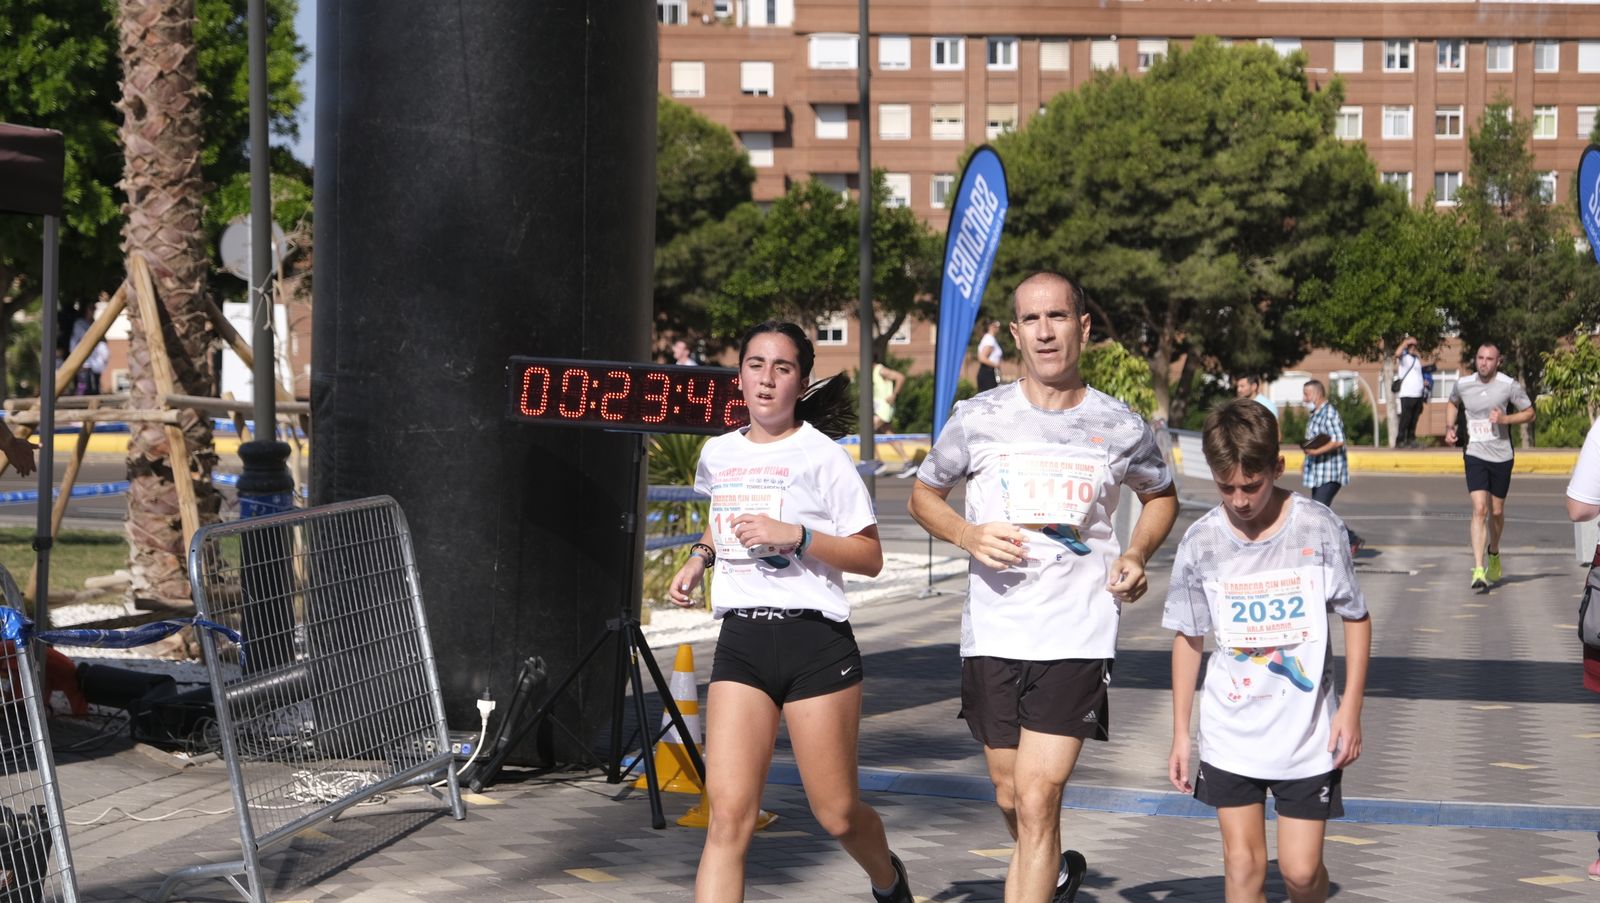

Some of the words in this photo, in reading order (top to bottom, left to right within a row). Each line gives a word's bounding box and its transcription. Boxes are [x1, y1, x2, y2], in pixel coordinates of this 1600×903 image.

[1023, 478, 1094, 503] 1110
[751, 607, 804, 620] PRO
[1231, 595, 1306, 623] 2032
